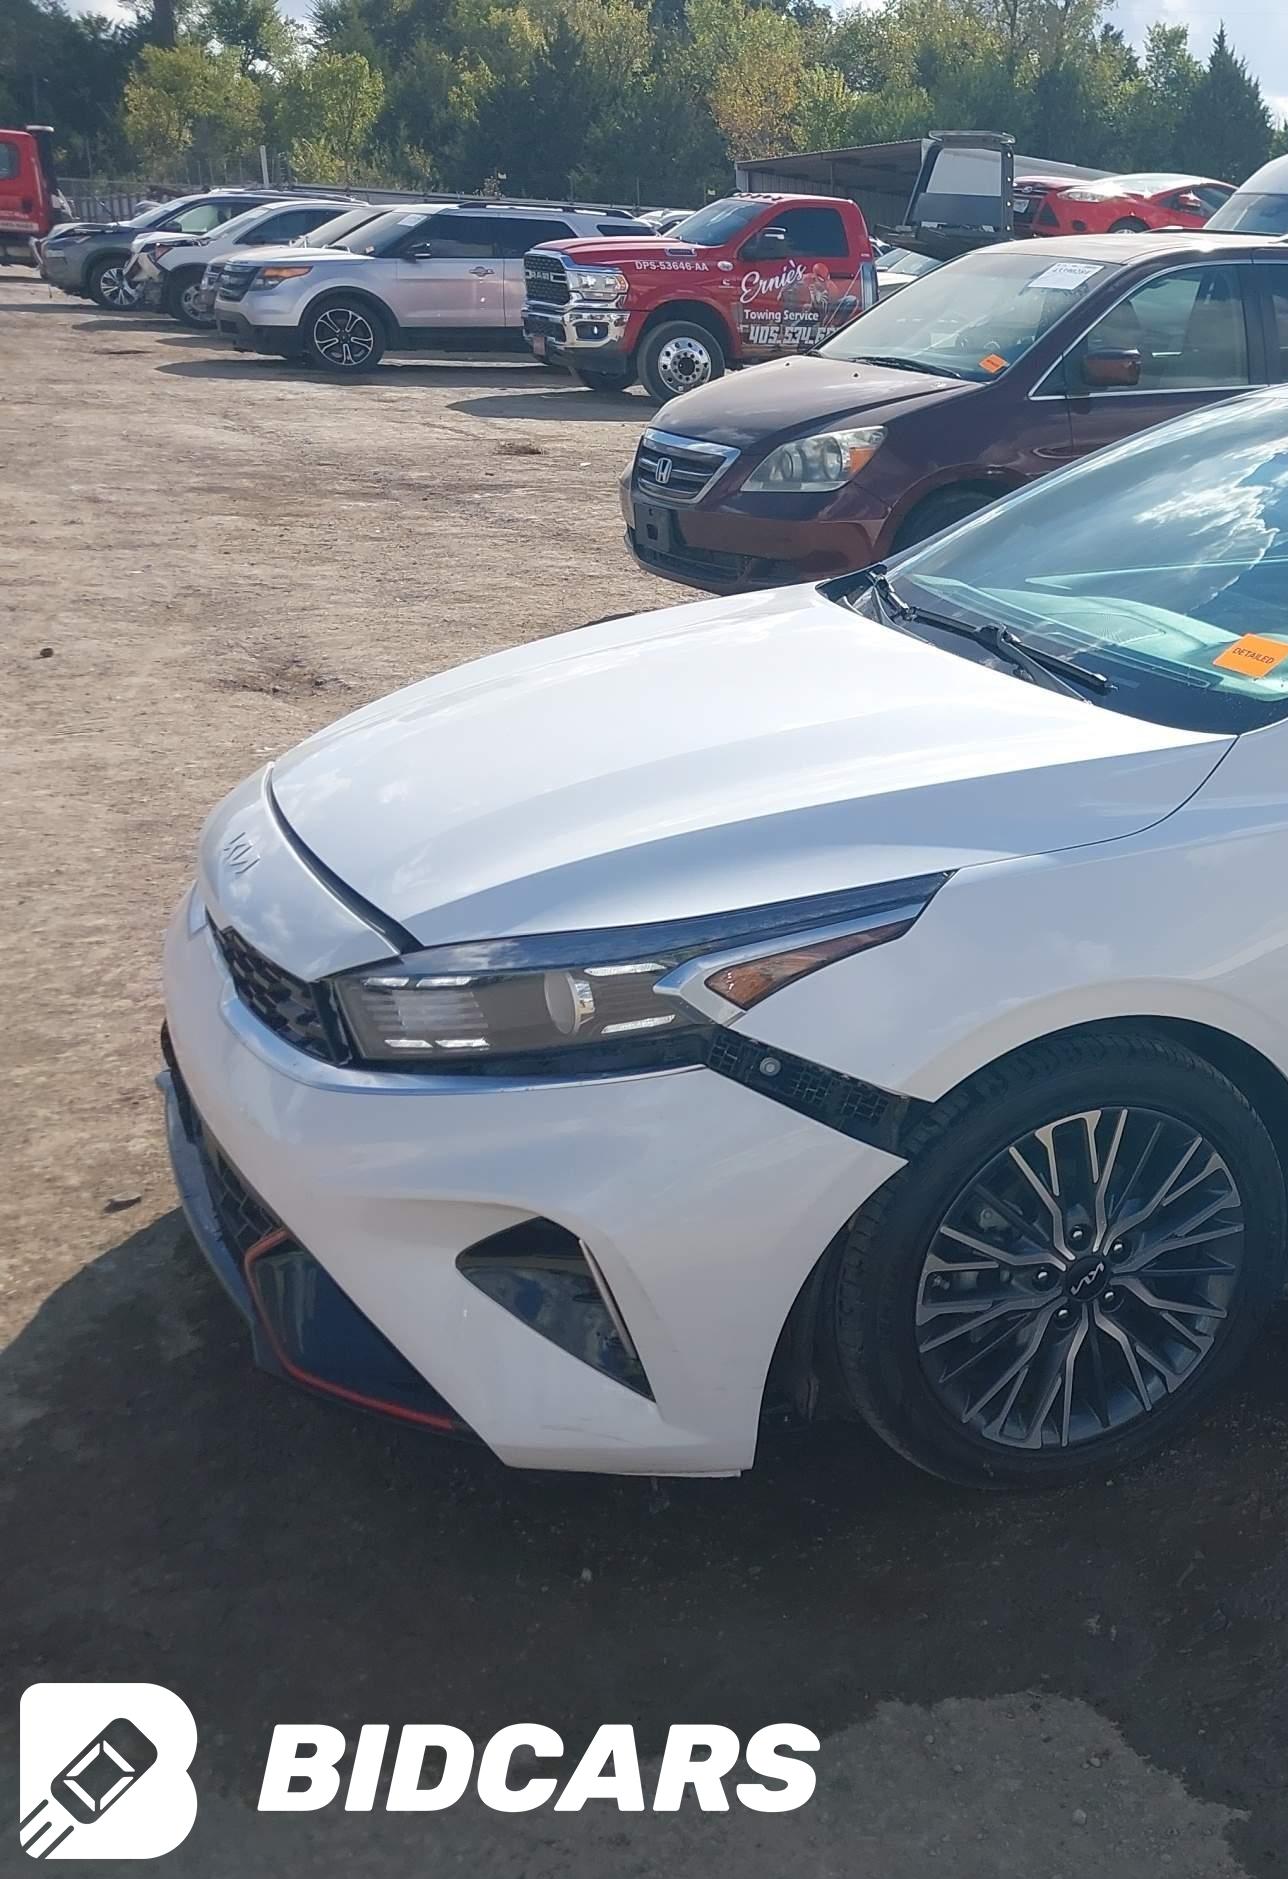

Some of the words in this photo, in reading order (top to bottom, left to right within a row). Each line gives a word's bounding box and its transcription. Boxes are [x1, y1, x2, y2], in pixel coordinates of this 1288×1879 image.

[744, 310, 781, 322] Towing
[783, 310, 819, 320] Service
[749, 323, 840, 344] 405.534.6
[1233, 647, 1275, 664] DETAILED
